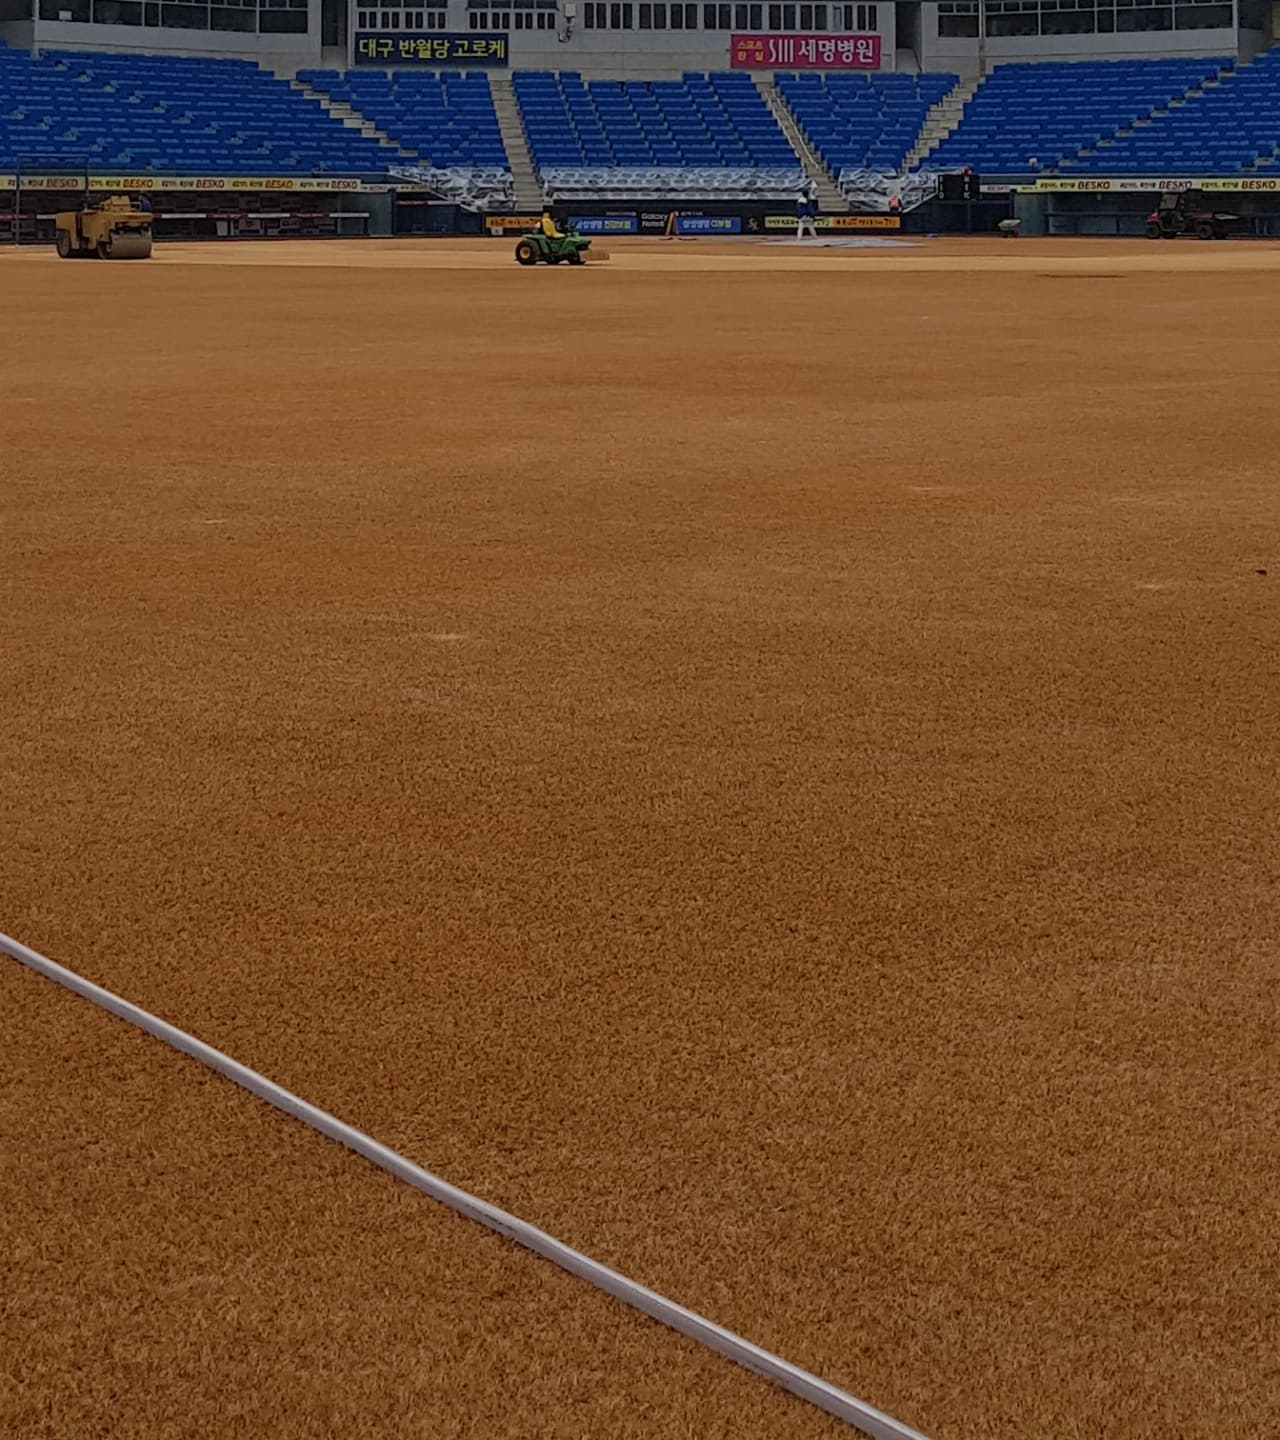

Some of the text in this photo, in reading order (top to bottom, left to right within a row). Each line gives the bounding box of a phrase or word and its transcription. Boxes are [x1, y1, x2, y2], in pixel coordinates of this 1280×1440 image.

[359, 38, 505, 59] 대구 반월당 고로케
[798, 39, 874, 63] 세명병원
[1077, 180, 1111, 190] BESKO
[1158, 180, 1192, 190] BESKO
[1241, 180, 1277, 190] BESKO
